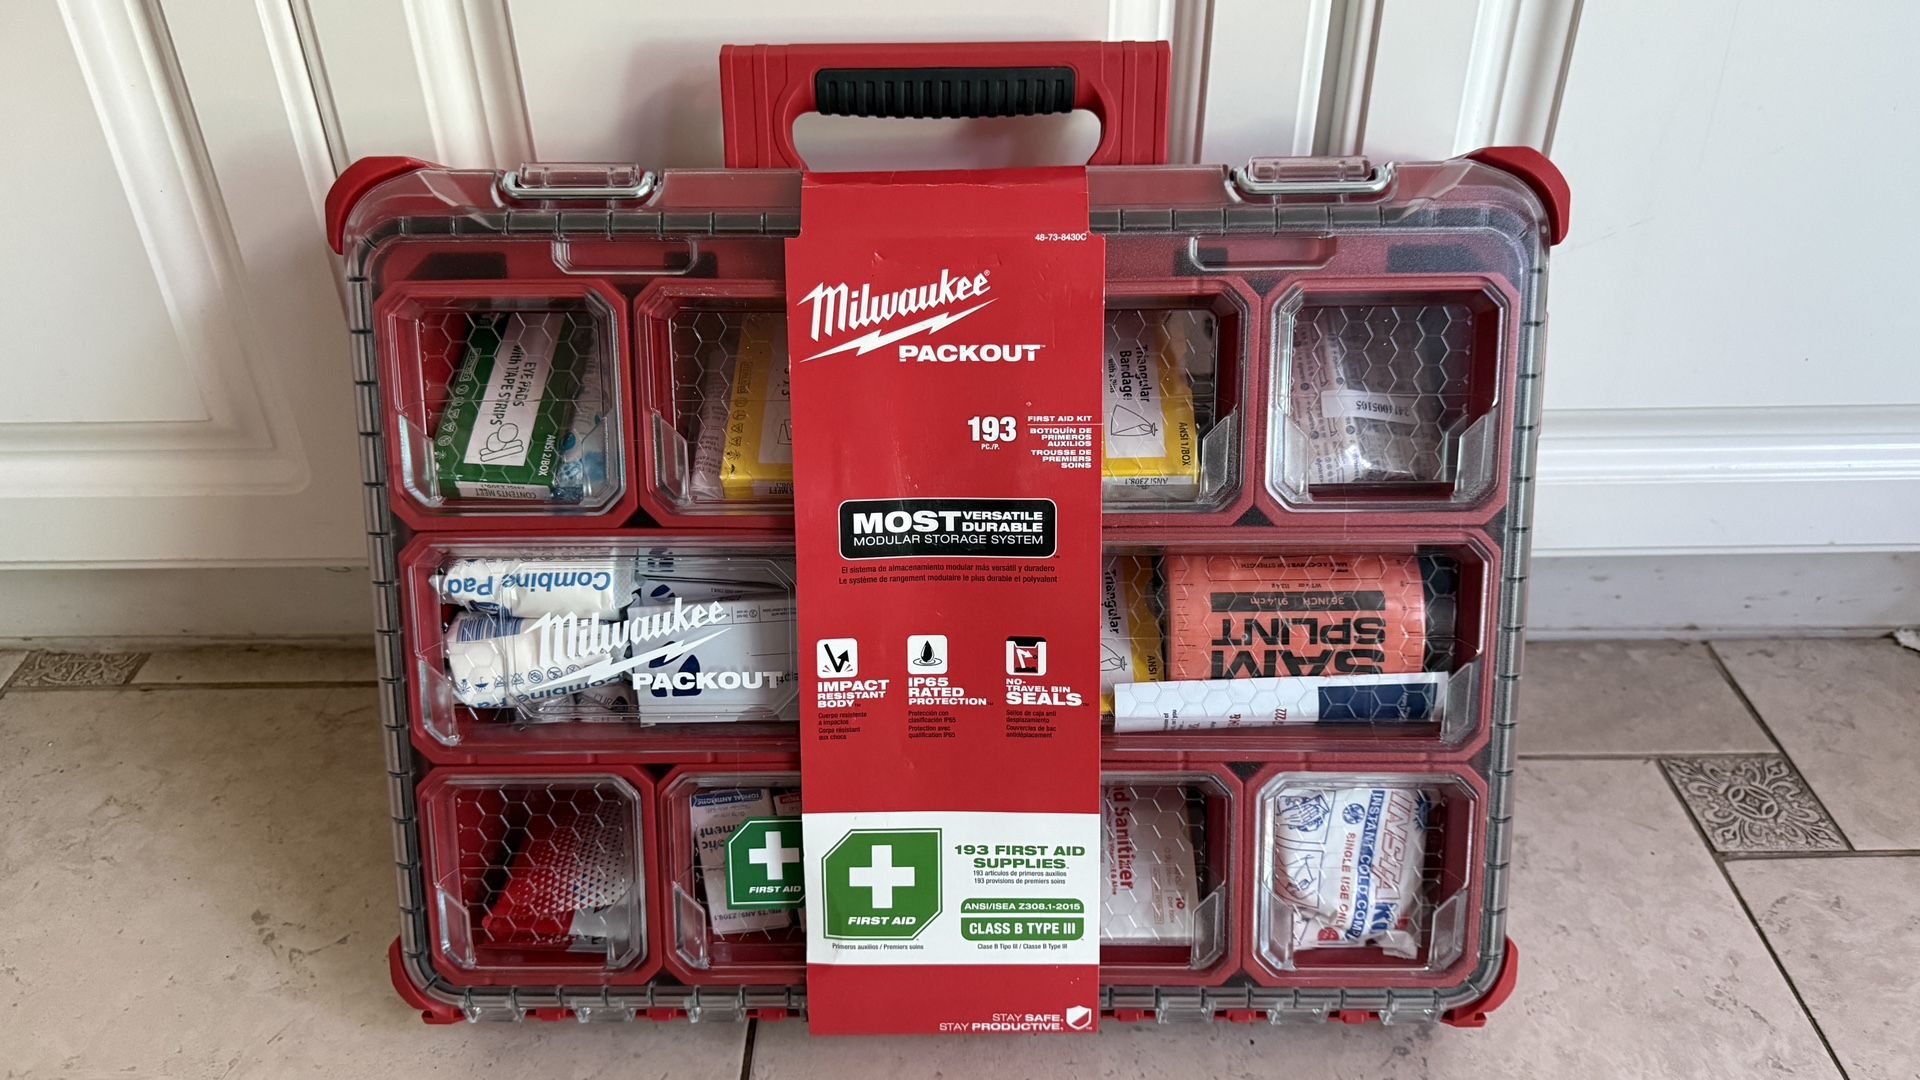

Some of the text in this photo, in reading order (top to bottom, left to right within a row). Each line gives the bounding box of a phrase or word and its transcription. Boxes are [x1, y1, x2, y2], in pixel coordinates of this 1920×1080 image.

[1035, 233, 1087, 242] 48-73-8430C
[797, 269, 991, 342] Milwaukee
[899, 344, 1041, 362] PACKOUT
[521, 362, 536, 380] EYE
[1136, 344, 1152, 402] Triangular
[968, 416, 1017, 442] 193
[1178, 422, 1191, 466] ANSI 1/BOX
[538, 434, 557, 476] ANSI 2/BOX
[853, 510, 961, 534] MOST
[962, 512, 1043, 520] VERSATILE
[962, 522, 1043, 533] DURABLE
[854, 534, 1044, 546] MODULAR STORAGE SYSTEM
[502, 571, 611, 592] Combine
[890, 575, 925, 583] rangement
[1023, 576, 1057, 584] polyvalent
[1104, 568, 1121, 634] Triangular
[1250, 596, 1344, 606] 36 INCH 91.4 cm
[524, 597, 727, 670] Milwaukee
[1212, 618, 1386, 646] SPLINT
[1147, 655, 1158, 675] ANSI
[1212, 650, 1385, 679] SAM
[632, 672, 783, 690] PACKOUT
[818, 680, 890, 692] IMPACT
[908, 678, 948, 686] IP65
[818, 691, 886, 700] RESISTANT
[908, 688, 964, 697] RATED
[1006, 692, 1082, 706] SEALS
[818, 700, 854, 708] BODY
[954, 845, 1085, 856] 193 FIRST AID
[1115, 806, 1134, 890] Sanitizer
[1340, 832, 1356, 872] SINGLE
[1356, 790, 1386, 900] INSTANT COLD
[1371, 790, 1413, 900] INSTA
[974, 858, 1066, 868] SUPPLIES
[749, 886, 782, 894] FIRST
[1340, 876, 1351, 900] USE
[848, 916, 916, 924] FIRST AID
[969, 922, 1076, 934] CLASS B TYPE III
[940, 1022, 1064, 1030] STAY PRODUCTIVE.
[992, 1014, 1064, 1022] STAY SAFE.
